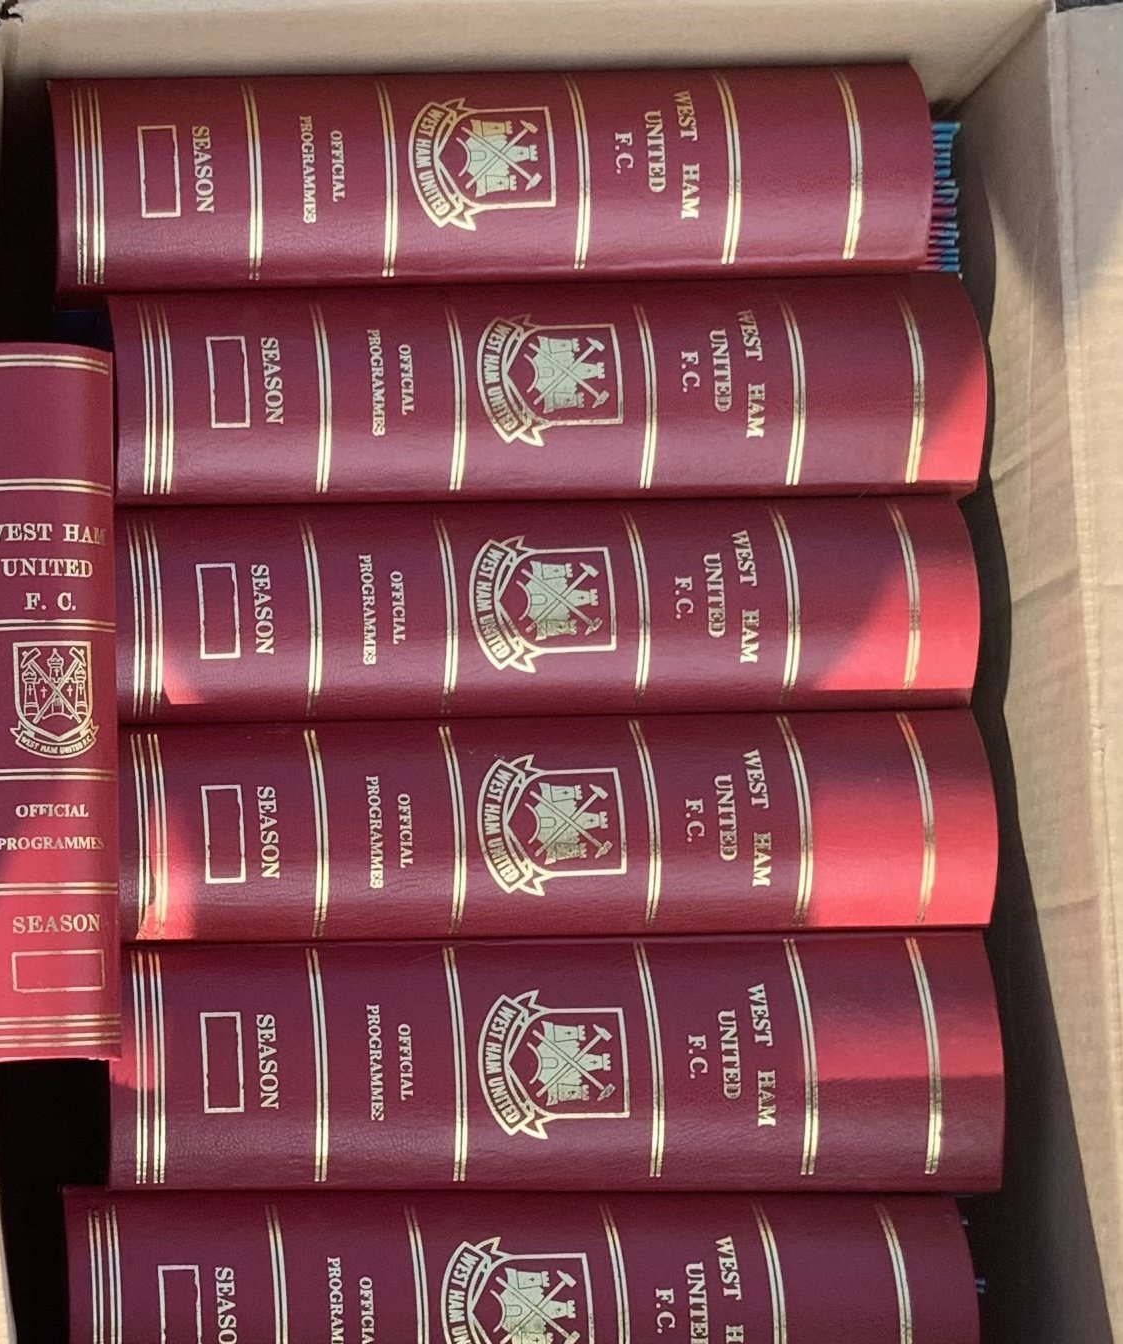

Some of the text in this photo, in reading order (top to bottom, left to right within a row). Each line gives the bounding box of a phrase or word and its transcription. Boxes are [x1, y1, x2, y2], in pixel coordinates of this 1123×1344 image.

[192, 126, 214, 213] SEASON
[645, 110, 666, 192] UNITED
[261, 337, 283, 424] SEASON
[710, 329, 732, 411] UNITED
[1, 558, 92, 577] UNITED
[63, 524, 108, 544] HAM
[251, 565, 274, 654] SEASON
[390, 571, 405, 644] OFFICIAL
[703, 553, 725, 637] UNITED
[732, 530, 759, 663] WEST HAM
[257, 787, 280, 878] SEASON
[366, 776, 384, 888] PROGRAMMES
[715, 775, 737, 861] UNITED
[743, 749, 771, 886] WEST HAM
[13, 914, 100, 933] SEASON
[256, 1015, 279, 1109] SEASON
[398, 1024, 413, 1100] OFFICIAL
[485, 1005, 521, 1124] WEST HAM UNITED
[718, 1010, 741, 1098] UNITED
[748, 984, 776, 1126] WEST HAM
[716, 1236, 740, 1300] WEST
